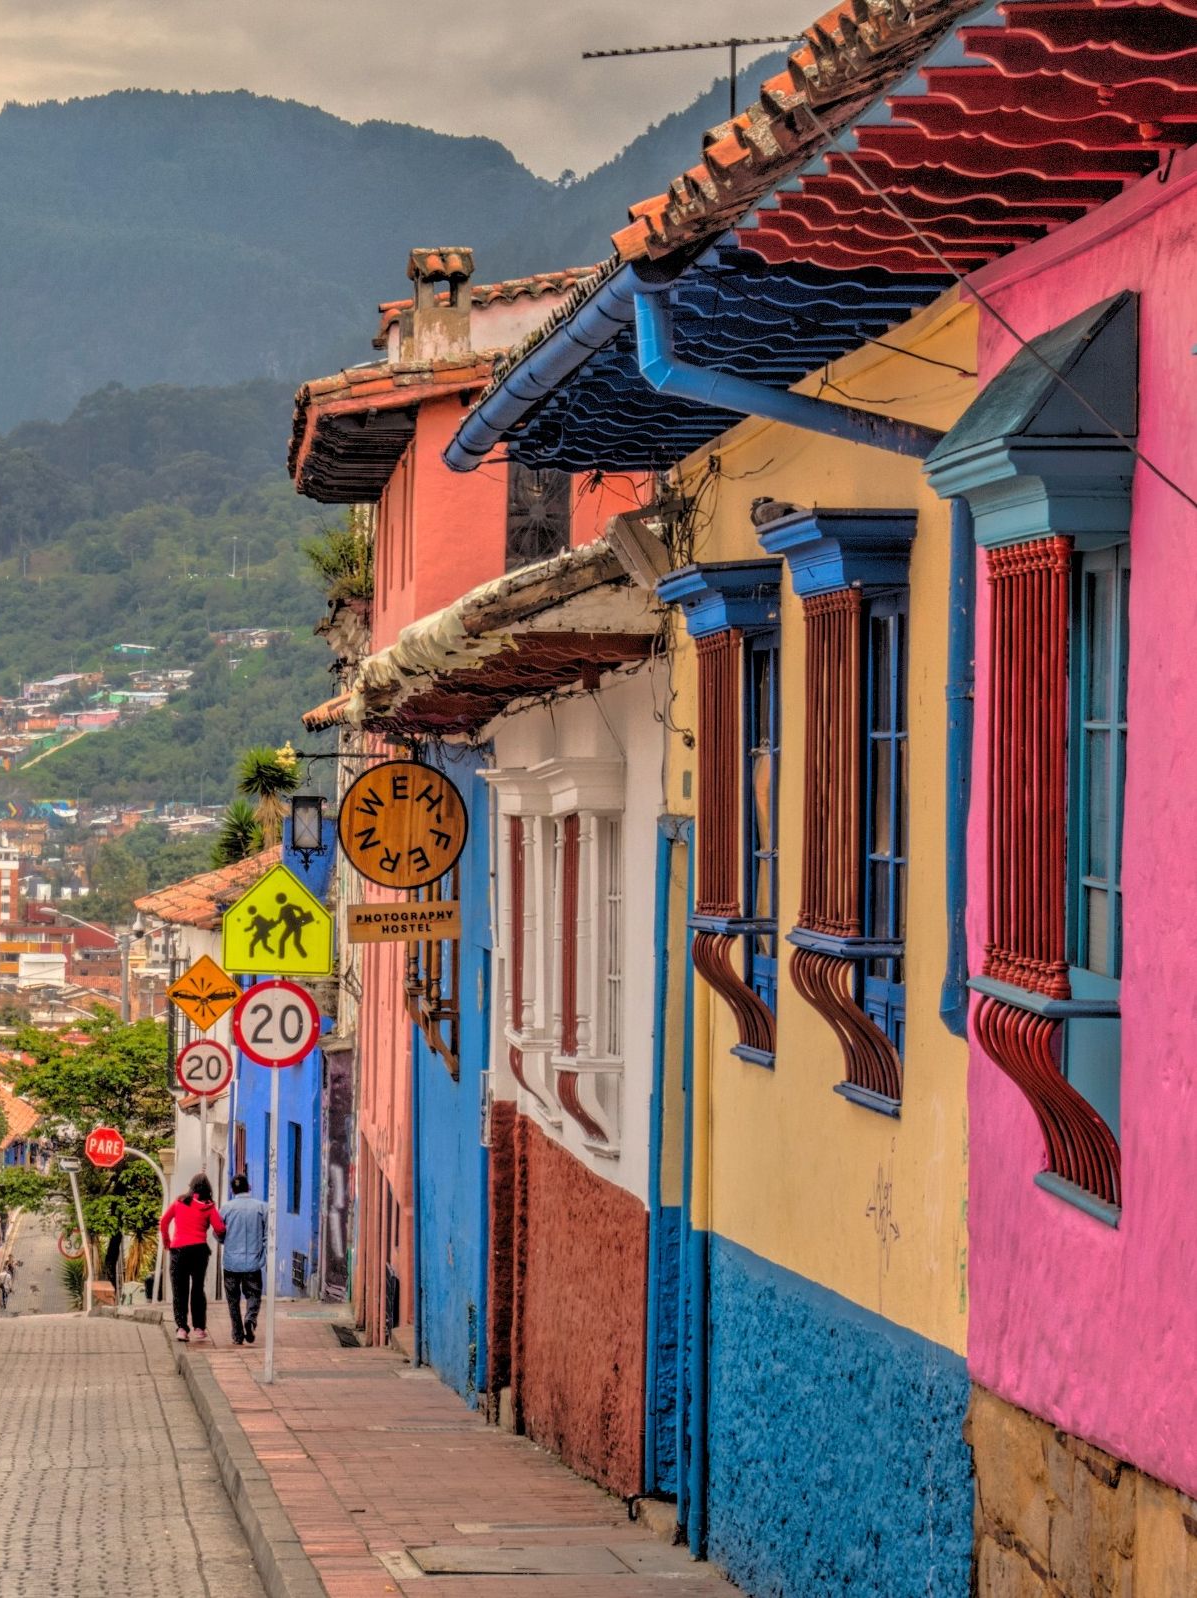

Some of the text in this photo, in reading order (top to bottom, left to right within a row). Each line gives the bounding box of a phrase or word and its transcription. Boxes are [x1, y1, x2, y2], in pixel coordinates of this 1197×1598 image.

[356, 910, 454, 923] PHOTOGRAPHY
[382, 923, 432, 934] HOSTEL
[250, 1003, 304, 1044] 20
[186, 1055, 222, 1080] 20
[89, 1138, 121, 1156] PARE
